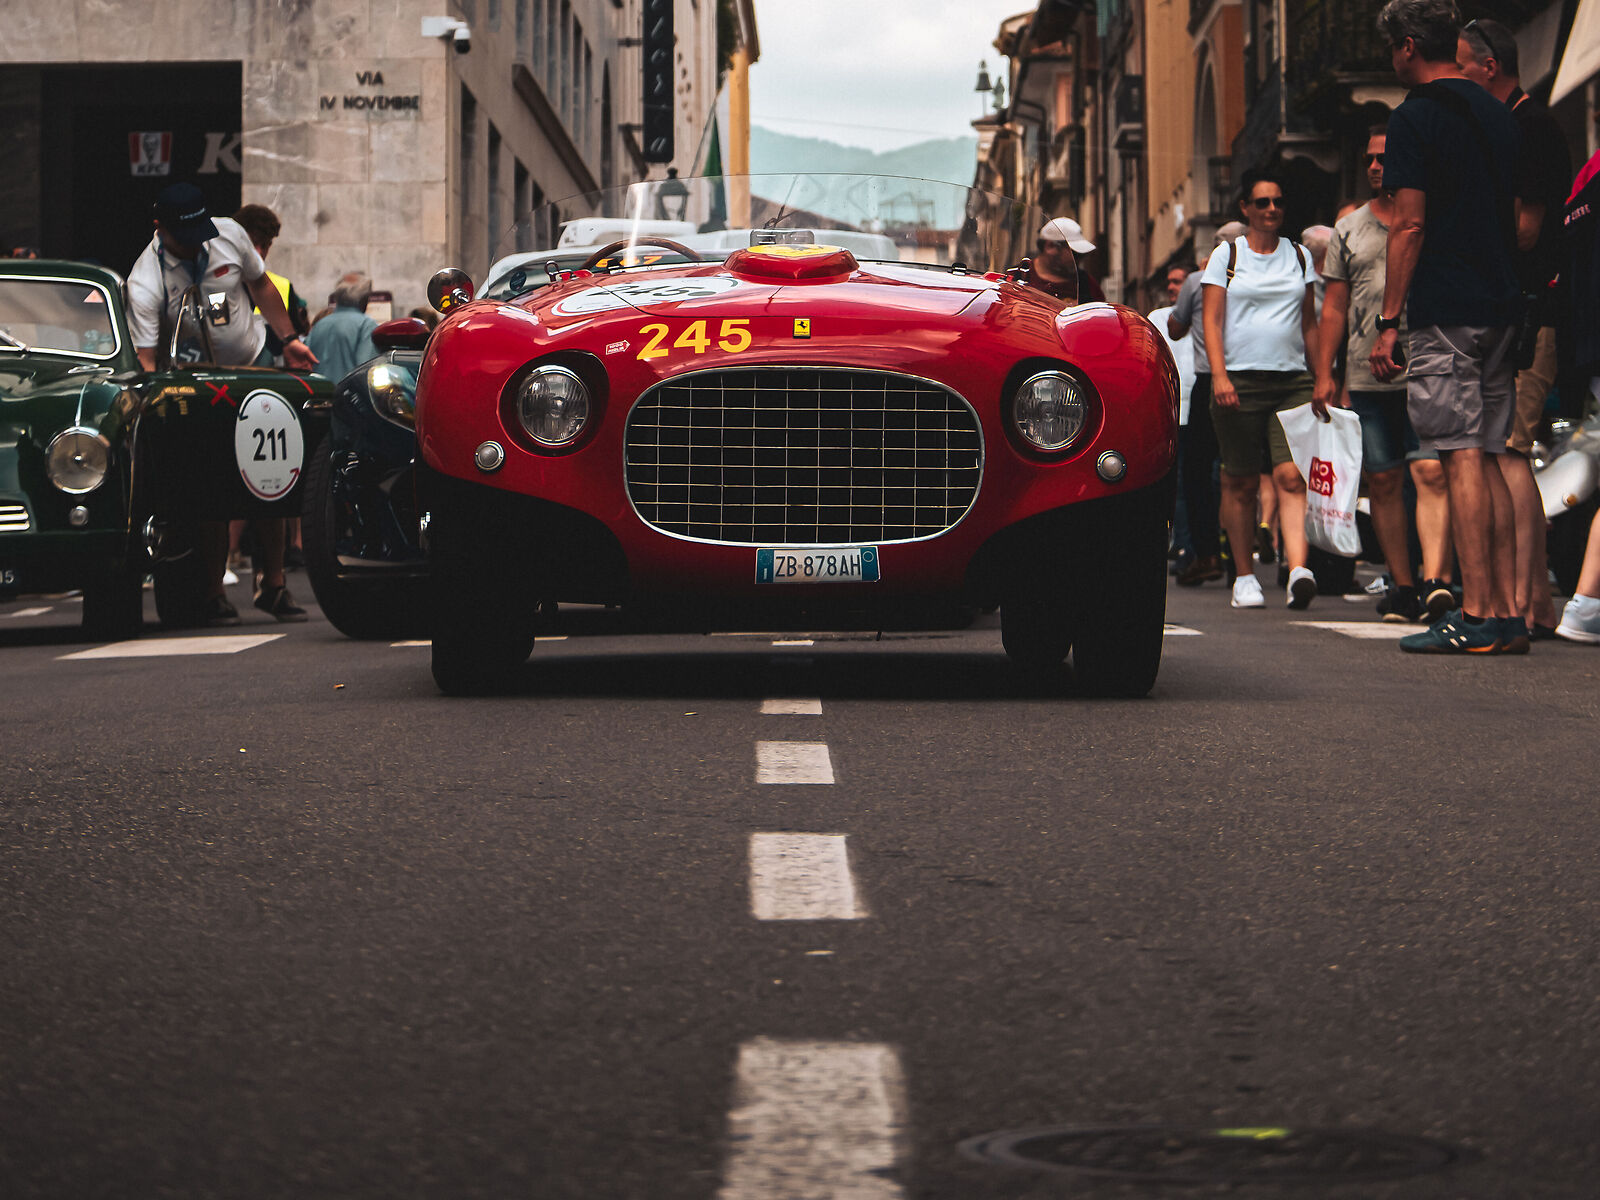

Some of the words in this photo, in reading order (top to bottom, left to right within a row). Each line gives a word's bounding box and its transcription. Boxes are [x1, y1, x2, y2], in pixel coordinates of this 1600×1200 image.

[356, 70, 384, 86] VIA
[320, 95, 337, 110] IV
[343, 95, 420, 110] NOVEMBRE
[636, 318, 753, 361] 245
[252, 428, 287, 461] 211
[775, 555, 797, 577] ZB
[803, 554, 861, 577] 878AH
